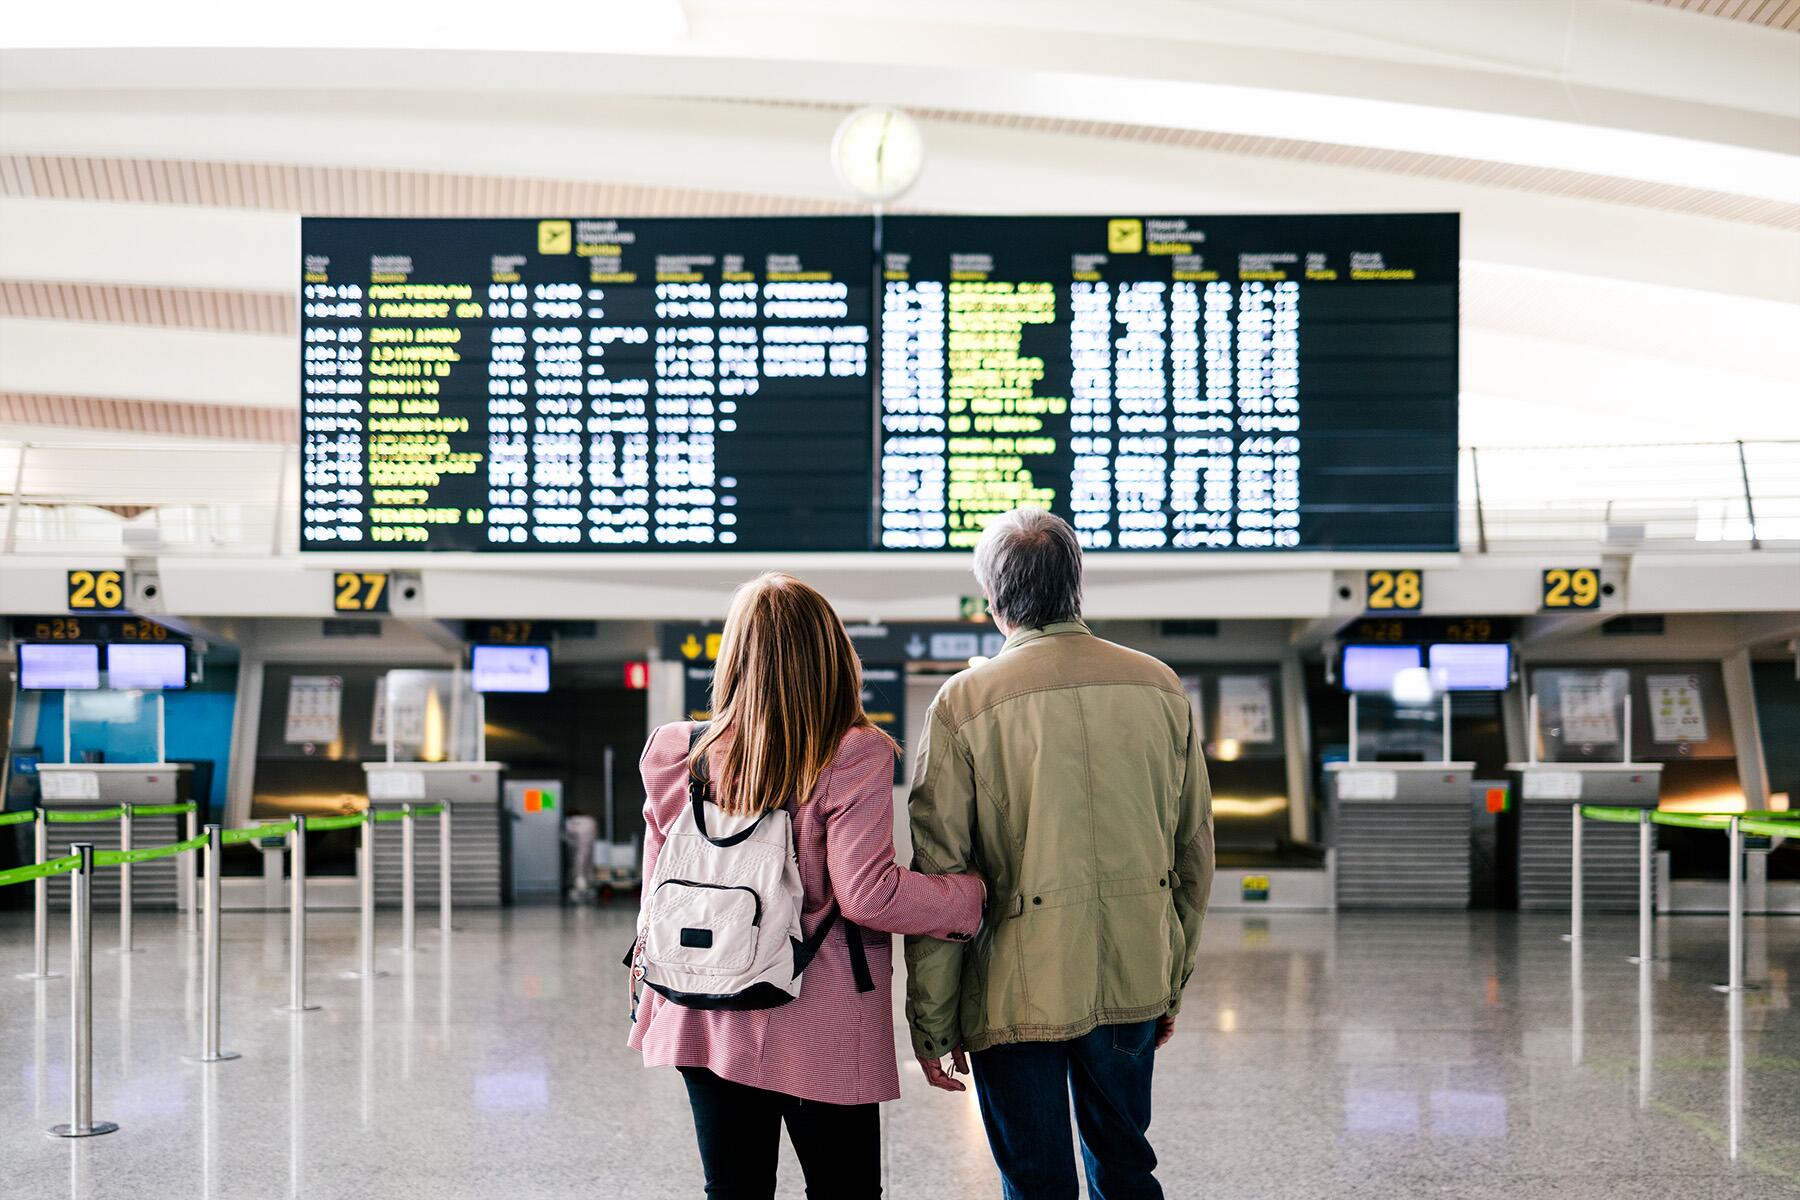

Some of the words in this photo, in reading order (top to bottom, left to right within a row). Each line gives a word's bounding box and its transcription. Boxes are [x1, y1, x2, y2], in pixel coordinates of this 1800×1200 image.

[70, 571, 123, 609] 26
[334, 572, 387, 610] 27
[1368, 570, 1422, 609] 28
[1545, 568, 1598, 606] 29
